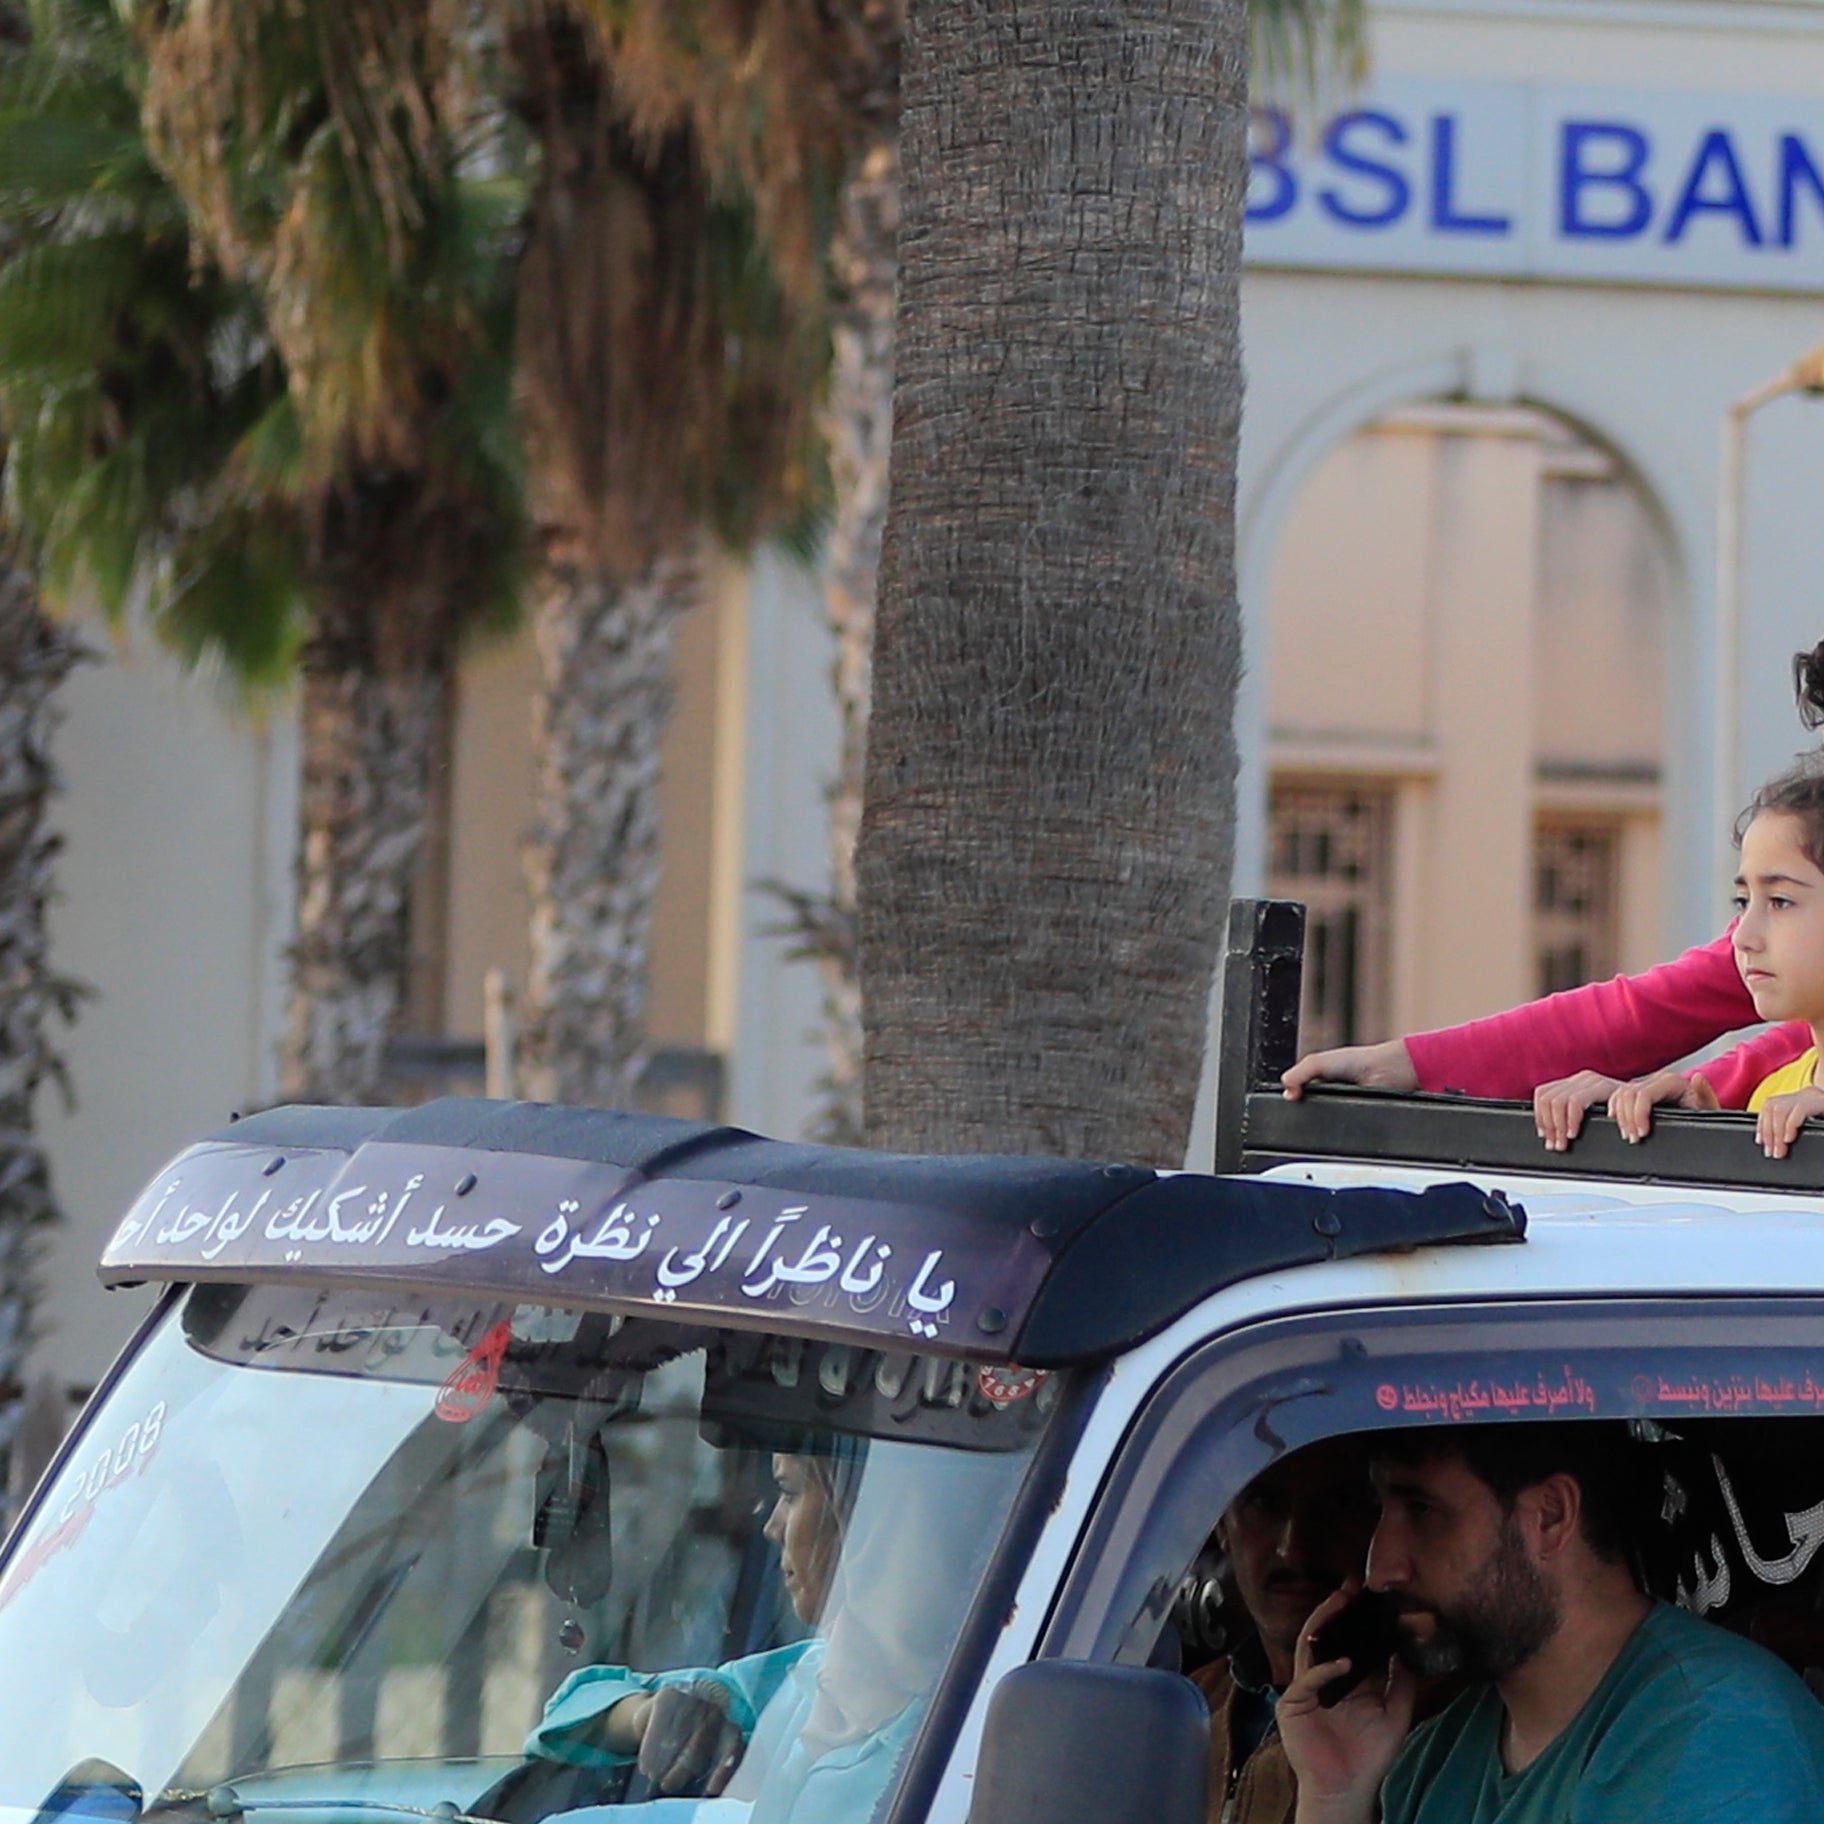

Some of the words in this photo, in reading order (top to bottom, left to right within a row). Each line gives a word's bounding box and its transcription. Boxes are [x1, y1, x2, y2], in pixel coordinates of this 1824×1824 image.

[1245, 107, 1511, 234] BSL
[107, 1179, 182, 1254] أح
[156, 1185, 273, 1261] لواحد
[406, 1203, 524, 1250] حسد
[534, 1200, 661, 1275] نظرة
[907, 1249, 956, 1341] يا
[1491, 1381, 1531, 1415] عليها
[1532, 1364, 1573, 1414] أصرف
[1755, 1375, 1797, 1411] عليها
[61, 1400, 168, 1521] 2008
